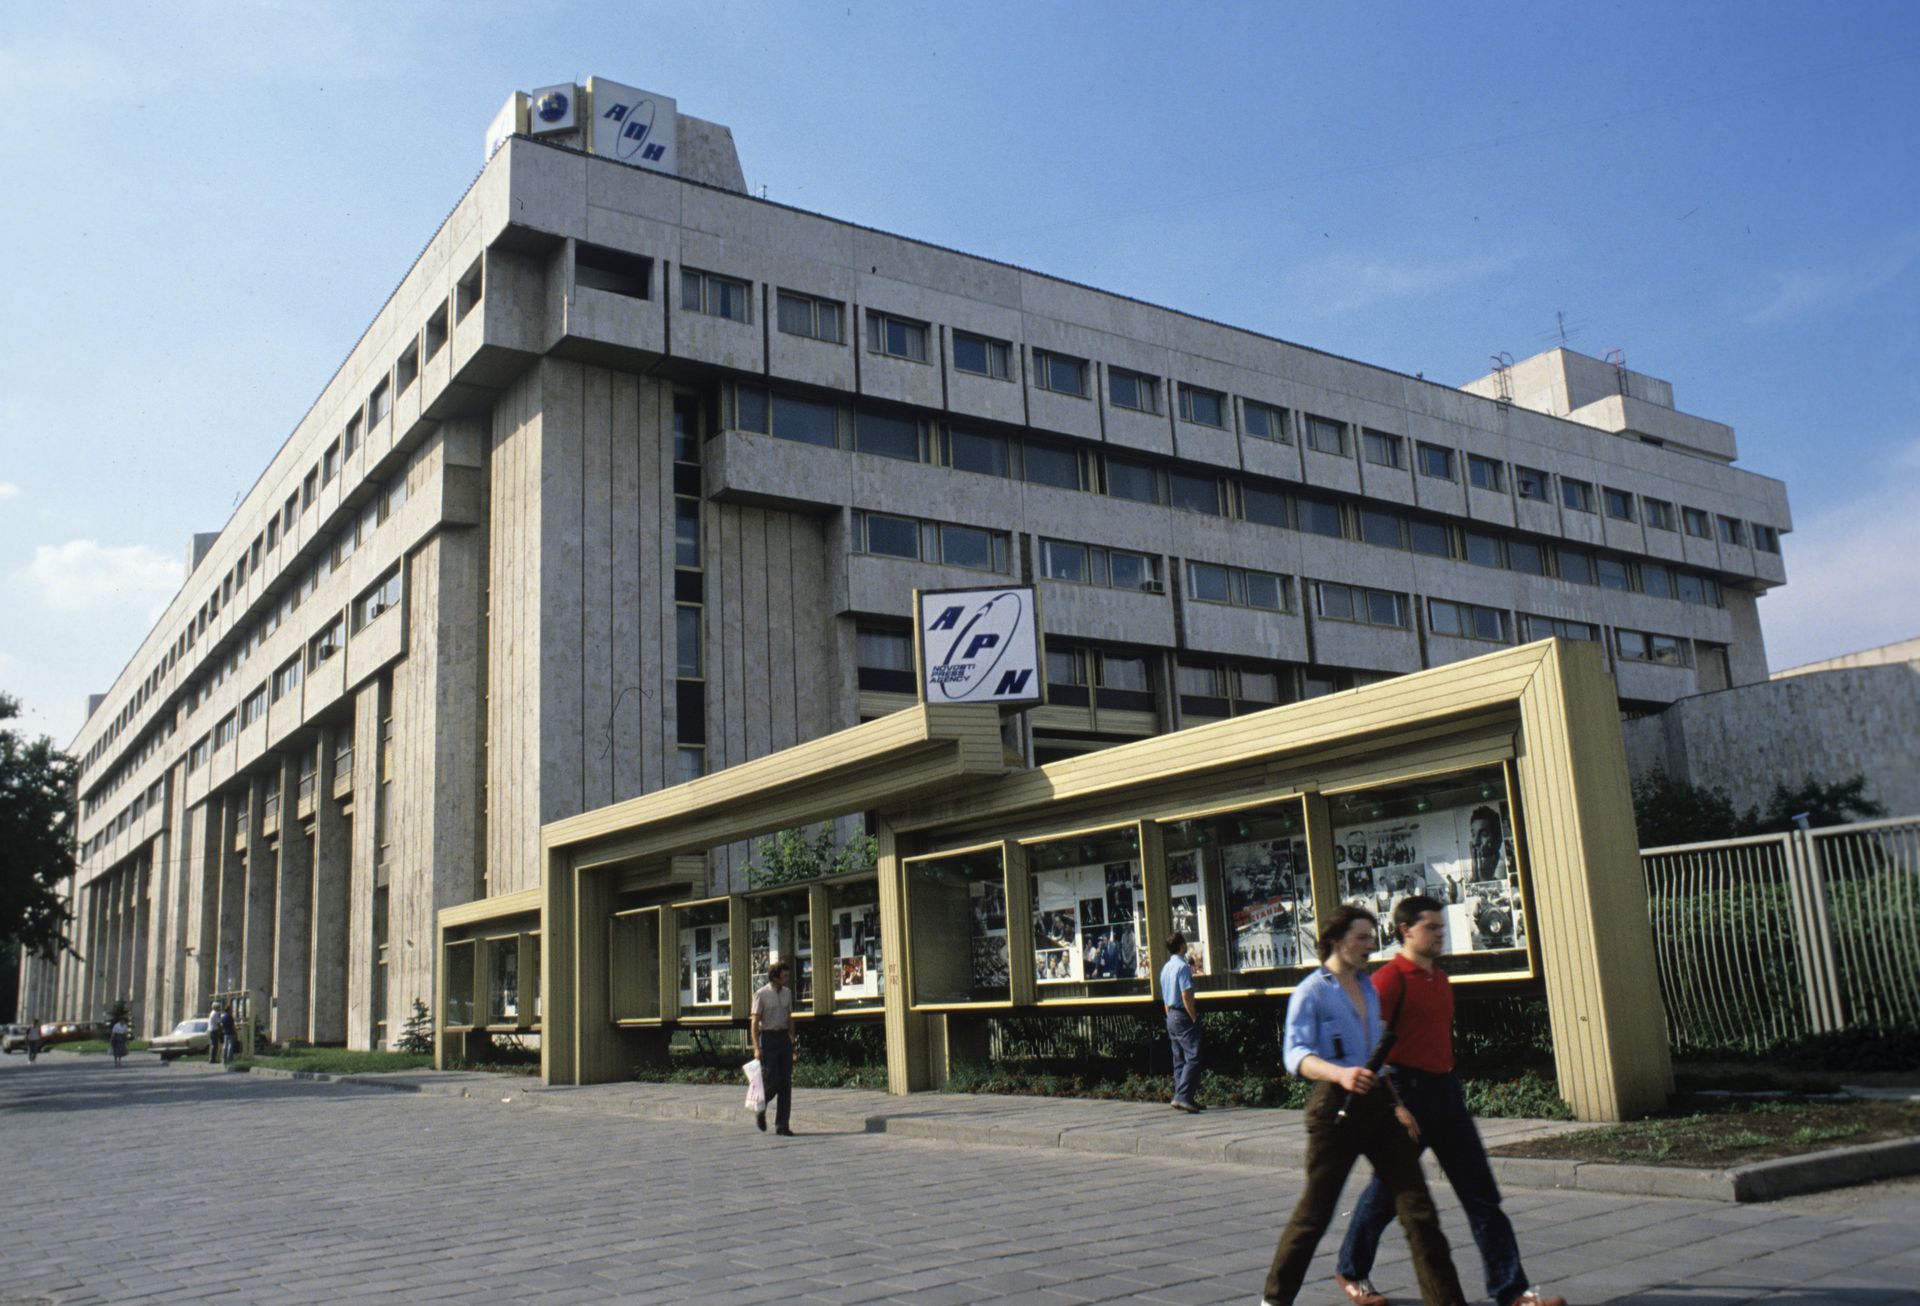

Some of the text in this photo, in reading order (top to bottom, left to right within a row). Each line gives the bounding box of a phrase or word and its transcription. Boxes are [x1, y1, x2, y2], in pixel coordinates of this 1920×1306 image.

[933, 663, 976, 672] NOVOSTI
[931, 669, 966, 678] PRESS
[929, 675, 971, 684] AGENCY
